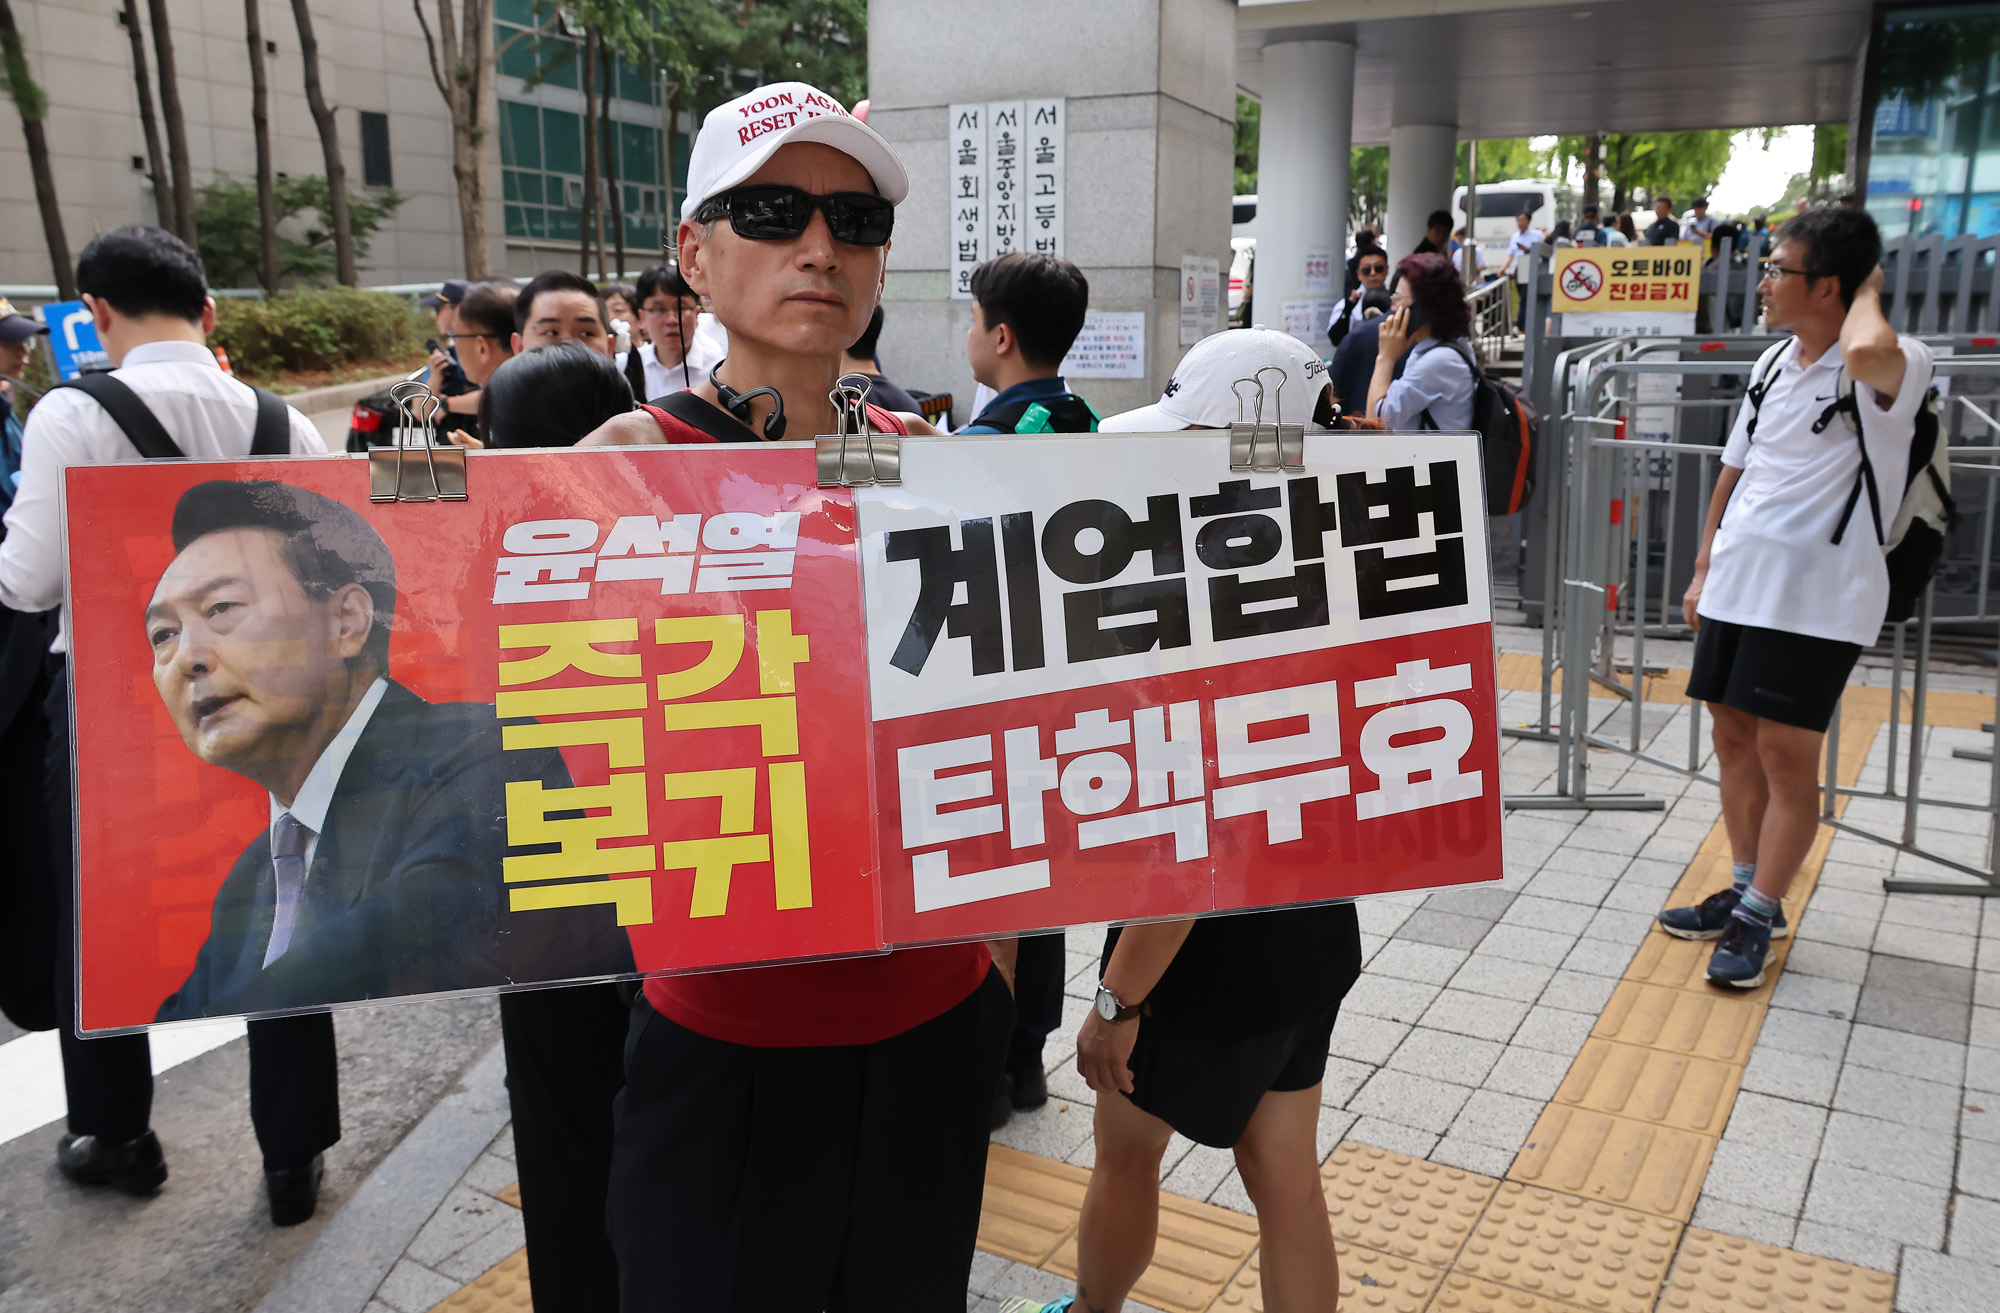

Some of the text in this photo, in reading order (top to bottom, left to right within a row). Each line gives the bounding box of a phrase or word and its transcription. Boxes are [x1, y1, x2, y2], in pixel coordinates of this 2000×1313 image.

[737, 112, 798, 146] RESET
[739, 93, 793, 118] YOON
[996, 108, 1017, 257] 서울중앙지방
[1609, 282, 1689, 301] 진입금지
[1611, 259, 1692, 277] 오토바이
[492, 511, 802, 605] 윤석열
[885, 460, 1469, 678] 계엄합법
[495, 608, 811, 769] 즉각
[502, 761, 813, 927] 복귀
[897, 658, 1484, 914] 탄핵무효
